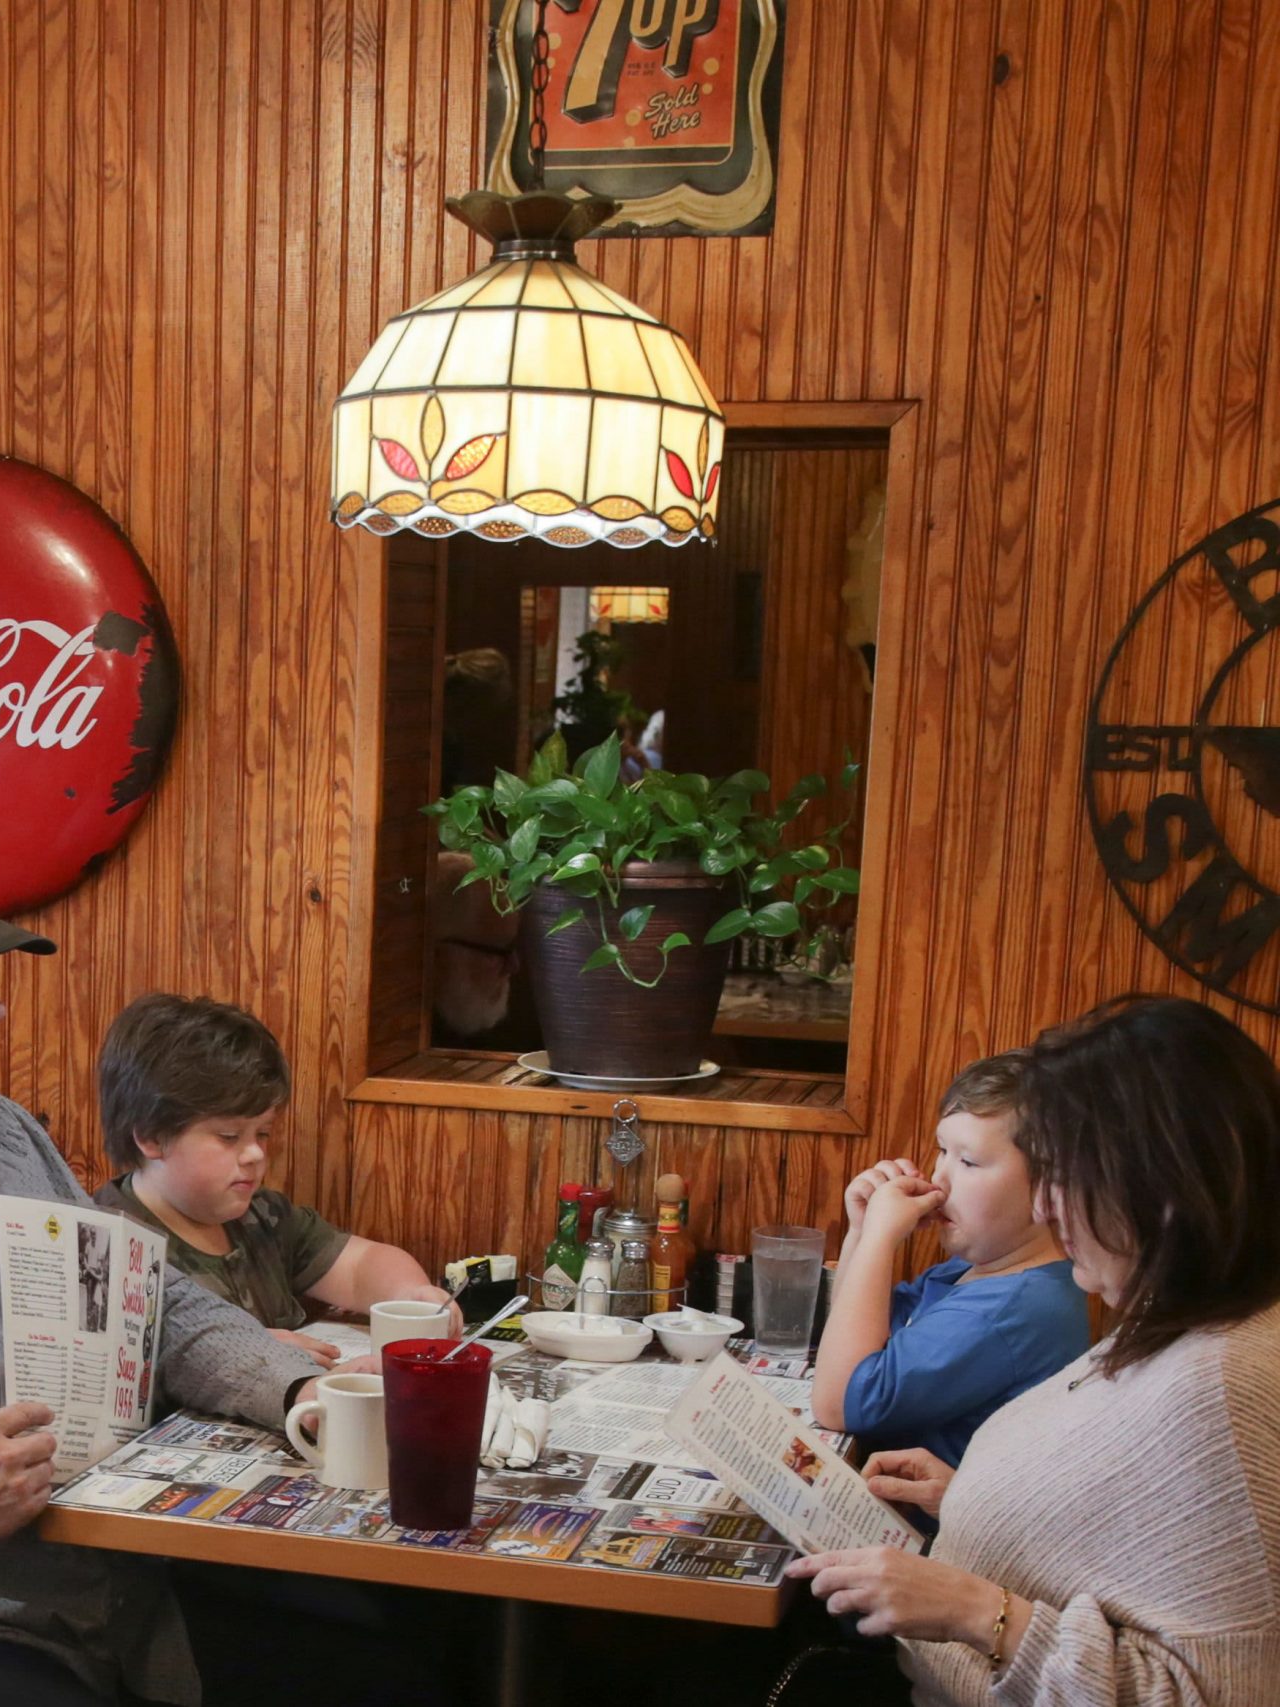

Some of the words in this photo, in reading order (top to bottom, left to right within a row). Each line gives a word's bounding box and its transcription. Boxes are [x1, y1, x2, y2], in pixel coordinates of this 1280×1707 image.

[645, 83, 700, 119] Sold
[651, 108, 702, 139] Here
[113, 1386, 133, 1419] 1956
[646, 1478, 682, 1501] BLVD
